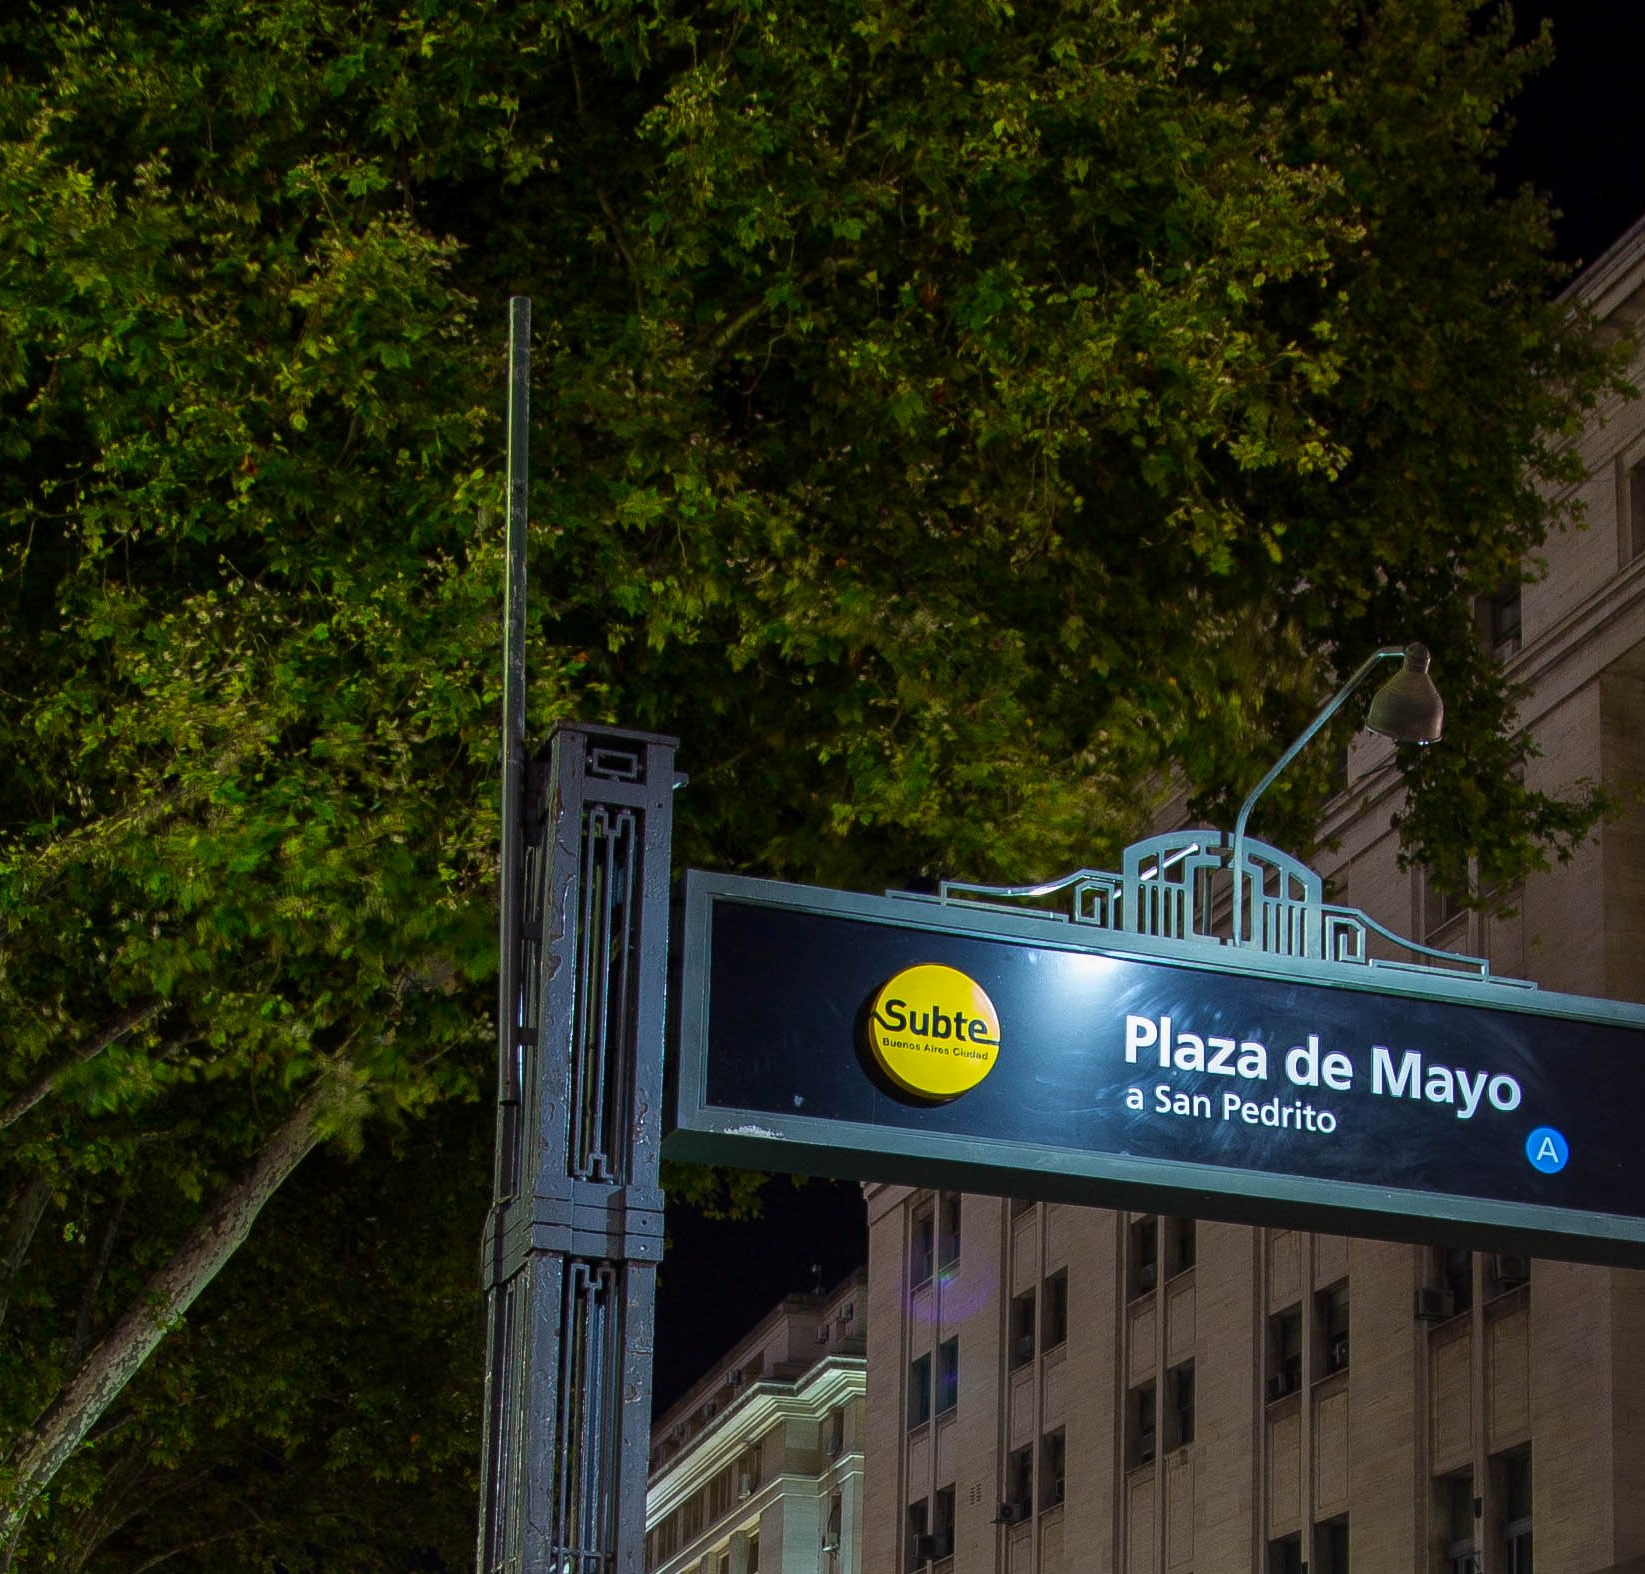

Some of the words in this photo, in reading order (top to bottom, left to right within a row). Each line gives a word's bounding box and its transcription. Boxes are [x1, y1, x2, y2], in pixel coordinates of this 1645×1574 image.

[873, 999, 999, 1045] Subte
[883, 1037, 921, 1051] Buenos
[924, 1044, 950, 1055] Aires
[952, 1047, 989, 1061] Ciudad
[1125, 1015, 1268, 1080] Plaza
[1285, 1034, 1354, 1090] de
[1372, 1046, 1522, 1119] Mayo
[1126, 1087, 1144, 1110] a
[1155, 1085, 1211, 1119] San
[1224, 1093, 1337, 1133] Pedrito
[1536, 1137, 1559, 1163] A
